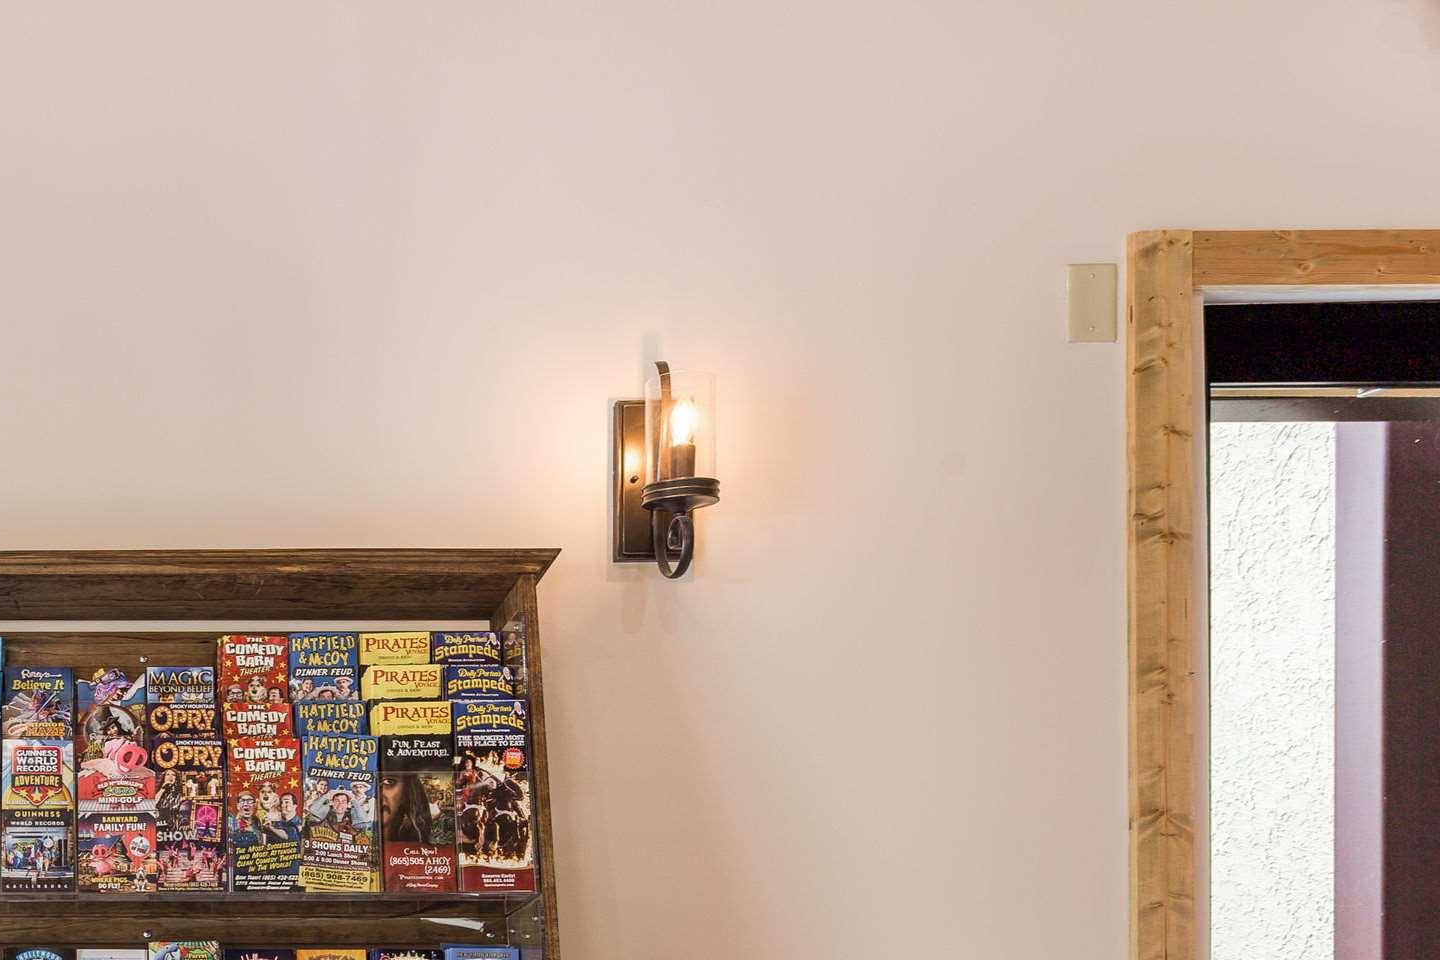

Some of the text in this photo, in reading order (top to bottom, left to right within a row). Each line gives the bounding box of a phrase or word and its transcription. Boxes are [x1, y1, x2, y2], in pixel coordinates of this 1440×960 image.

[225, 644, 284, 655] COMEDY
[292, 636, 355, 651] HATFIELD
[365, 638, 428, 653] PIRATES
[435, 644, 499, 661] Stampede
[236, 655, 274, 667] BARN
[149, 671, 211, 685] MAGIC
[373, 670, 438, 685] PIRATES
[149, 685, 184, 693] BEYOND
[448, 677, 512, 695] Stampede
[227, 711, 287, 722] COMEDY
[300, 704, 364, 718] HATFIELD
[383, 707, 449, 721] PIRATES
[150, 706, 216, 731] OPRY
[457, 714, 525, 730] Stampede
[237, 723, 276, 735] BARN
[312, 736, 376, 753] HATFIELD
[156, 742, 222, 768] OPRY
[233, 747, 296, 760] COMEDY
[16, 765, 58, 773] RECORDS
[244, 759, 286, 773] BARN
[14, 776, 60, 786] ADVENTURE
[94, 823, 146, 832] FAMILY FUN!
[312, 842, 342, 850] SHOWS
[345, 844, 368, 853] DAILY
